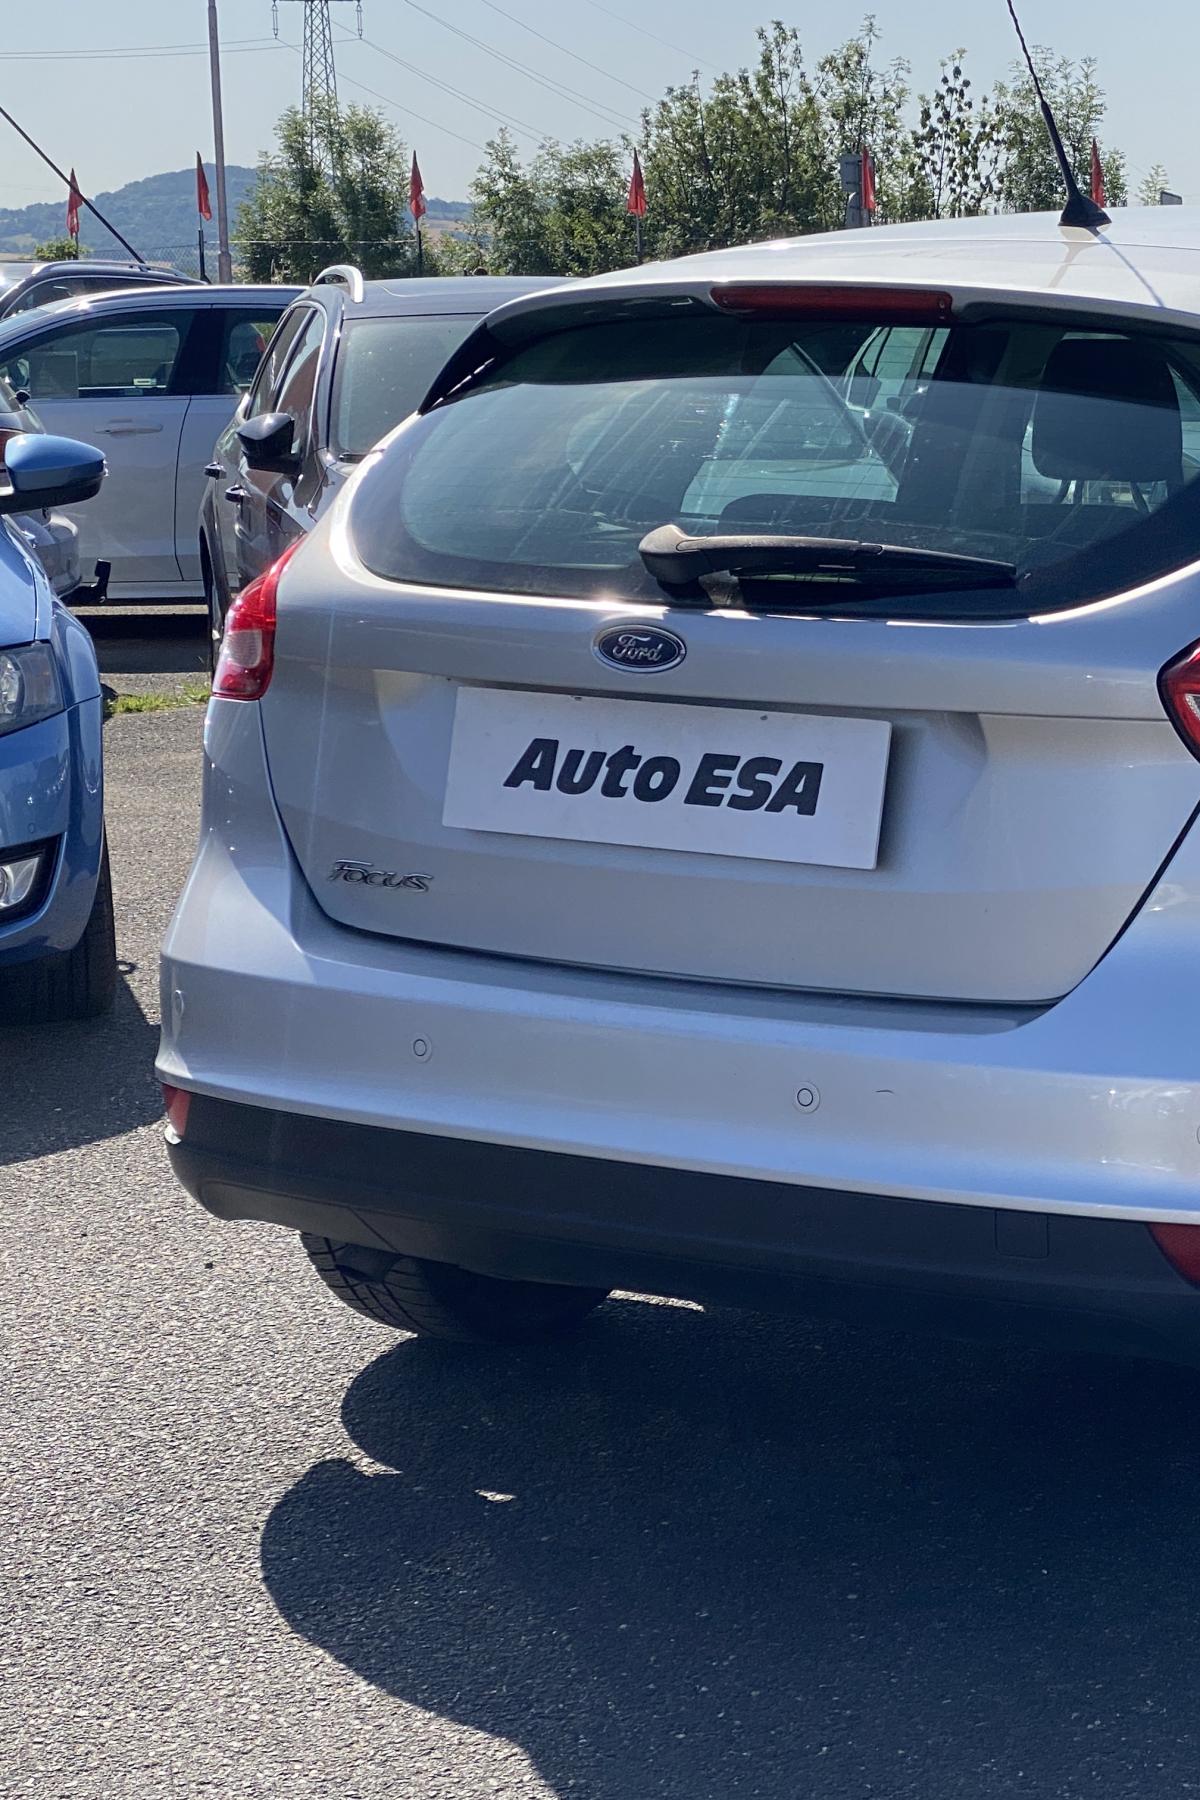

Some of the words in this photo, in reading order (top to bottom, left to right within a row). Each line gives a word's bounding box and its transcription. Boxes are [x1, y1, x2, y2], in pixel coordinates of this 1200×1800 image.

[612, 633, 664, 662] Ford
[503, 737, 682, 803] Auto
[683, 752, 825, 817] ESA
